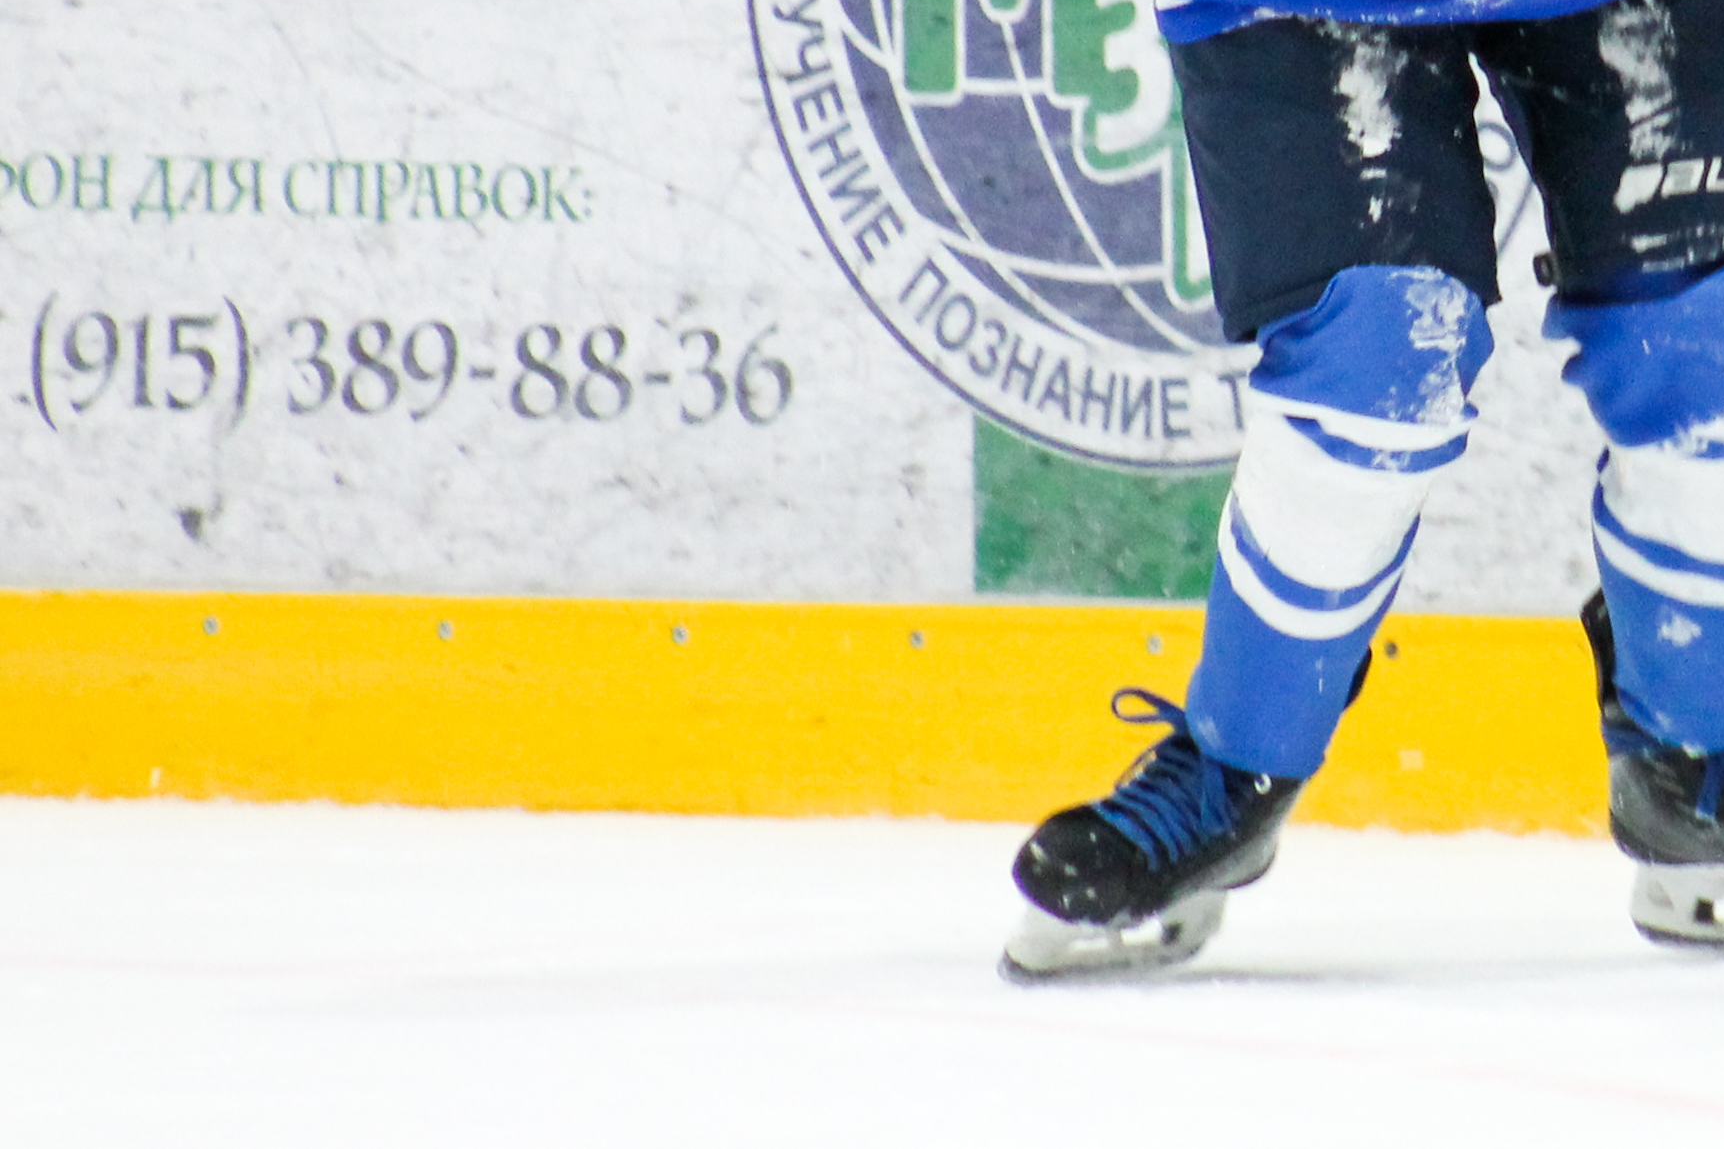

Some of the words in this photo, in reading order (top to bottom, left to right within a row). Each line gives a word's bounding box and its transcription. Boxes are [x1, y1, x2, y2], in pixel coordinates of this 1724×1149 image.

[130, 156, 263, 223] ДЛЯ
[283, 159, 594, 224] СПРАВОК:
[31, 291, 252, 431] (915)
[284, 314, 796, 428] 389-88-36
[899, 256, 1192, 441] ПОЗНАНИЕ
